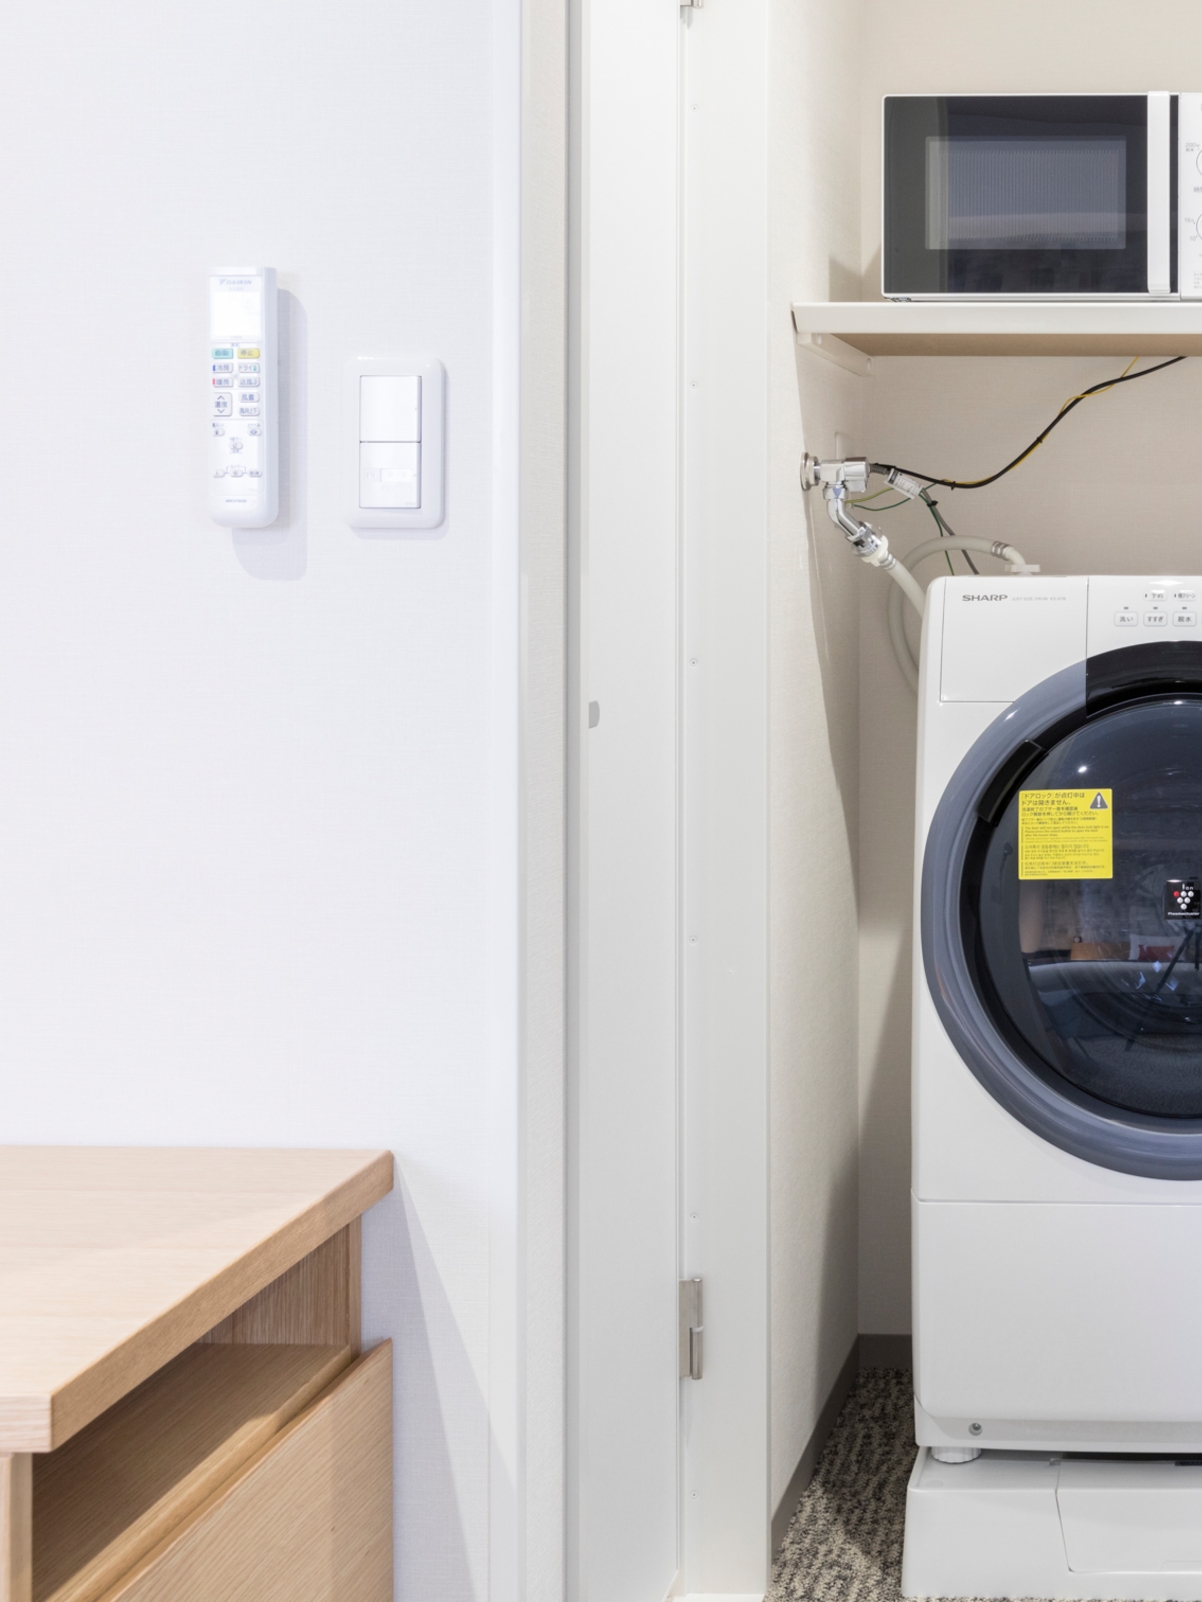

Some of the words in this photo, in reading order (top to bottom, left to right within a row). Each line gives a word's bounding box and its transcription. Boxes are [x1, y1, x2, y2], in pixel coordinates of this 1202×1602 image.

[962, 594, 1008, 602] SHARP
[1119, 615, 1134, 623] 洗い
[1147, 615, 1164, 623] すすぎ
[1177, 615, 1192, 623] 脱水
